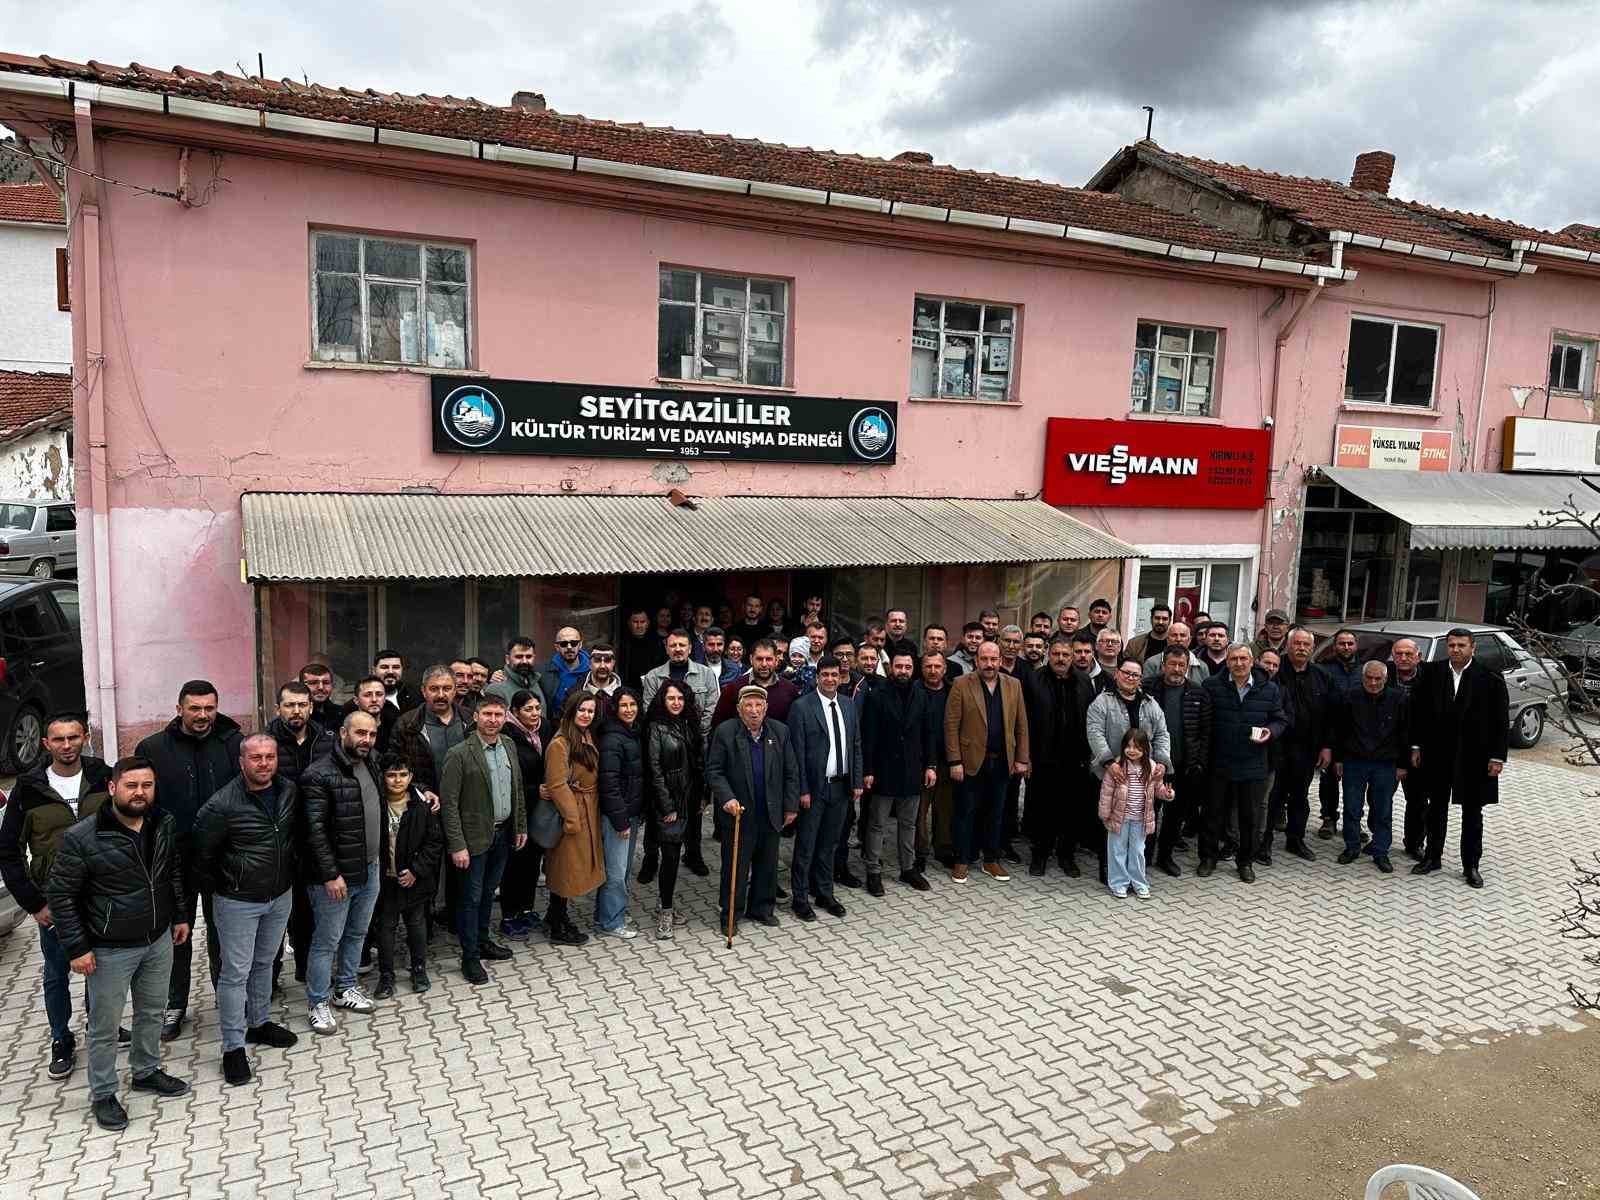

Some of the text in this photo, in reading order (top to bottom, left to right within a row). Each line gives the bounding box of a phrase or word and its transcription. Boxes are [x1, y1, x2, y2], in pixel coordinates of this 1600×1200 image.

[580, 393, 791, 426] SEYİTGAZİLİLER
[511, 419, 843, 449] KÜLTÜR TURİZM VE DAYANIŞMA DERNEĞİ
[1339, 444, 1368, 456] STIHL
[1373, 437, 1421, 451] YÜKSEL YILMAZ
[680, 447, 699, 456] 1953
[1422, 448, 1448, 460] STIHL
